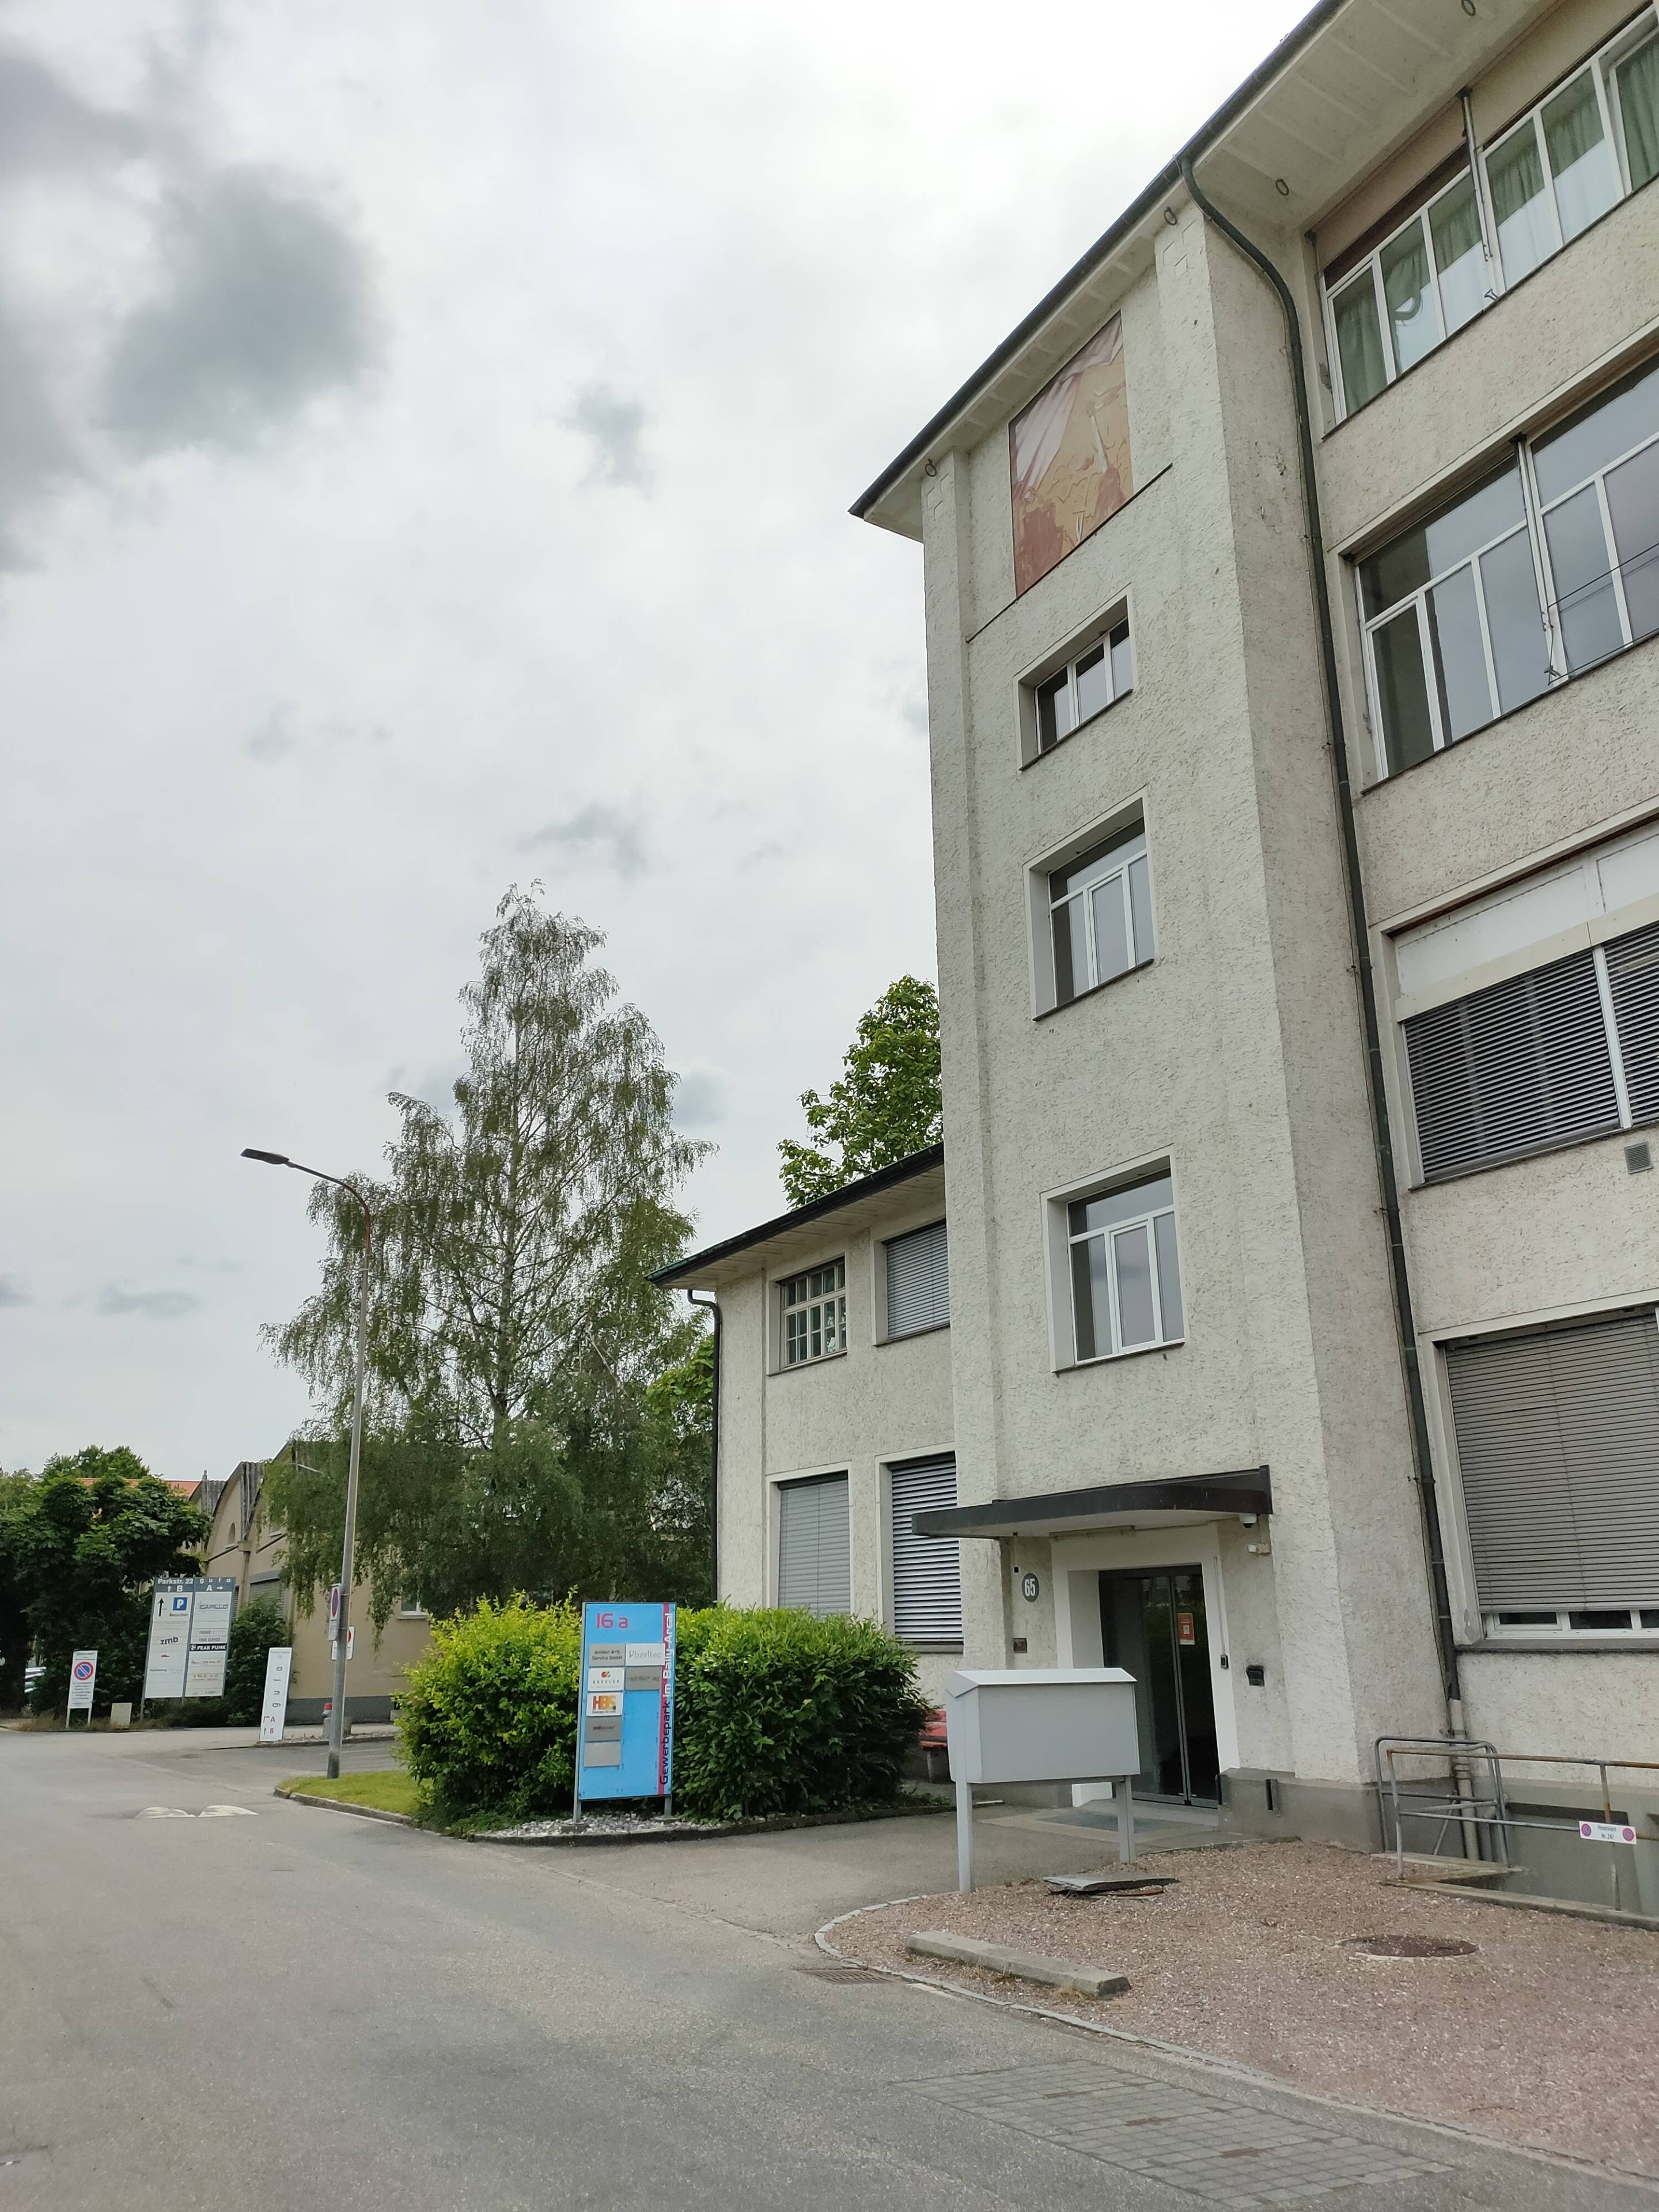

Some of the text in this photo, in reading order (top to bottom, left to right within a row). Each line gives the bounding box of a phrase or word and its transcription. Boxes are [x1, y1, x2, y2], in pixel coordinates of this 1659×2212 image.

[1024, 1578, 1036, 1597] 65
[596, 1613, 628, 1629] 16 a
[160, 1637, 179, 1645] zmb
[660, 1612, 673, 1785] Gewerbepark im Bally-Areal
